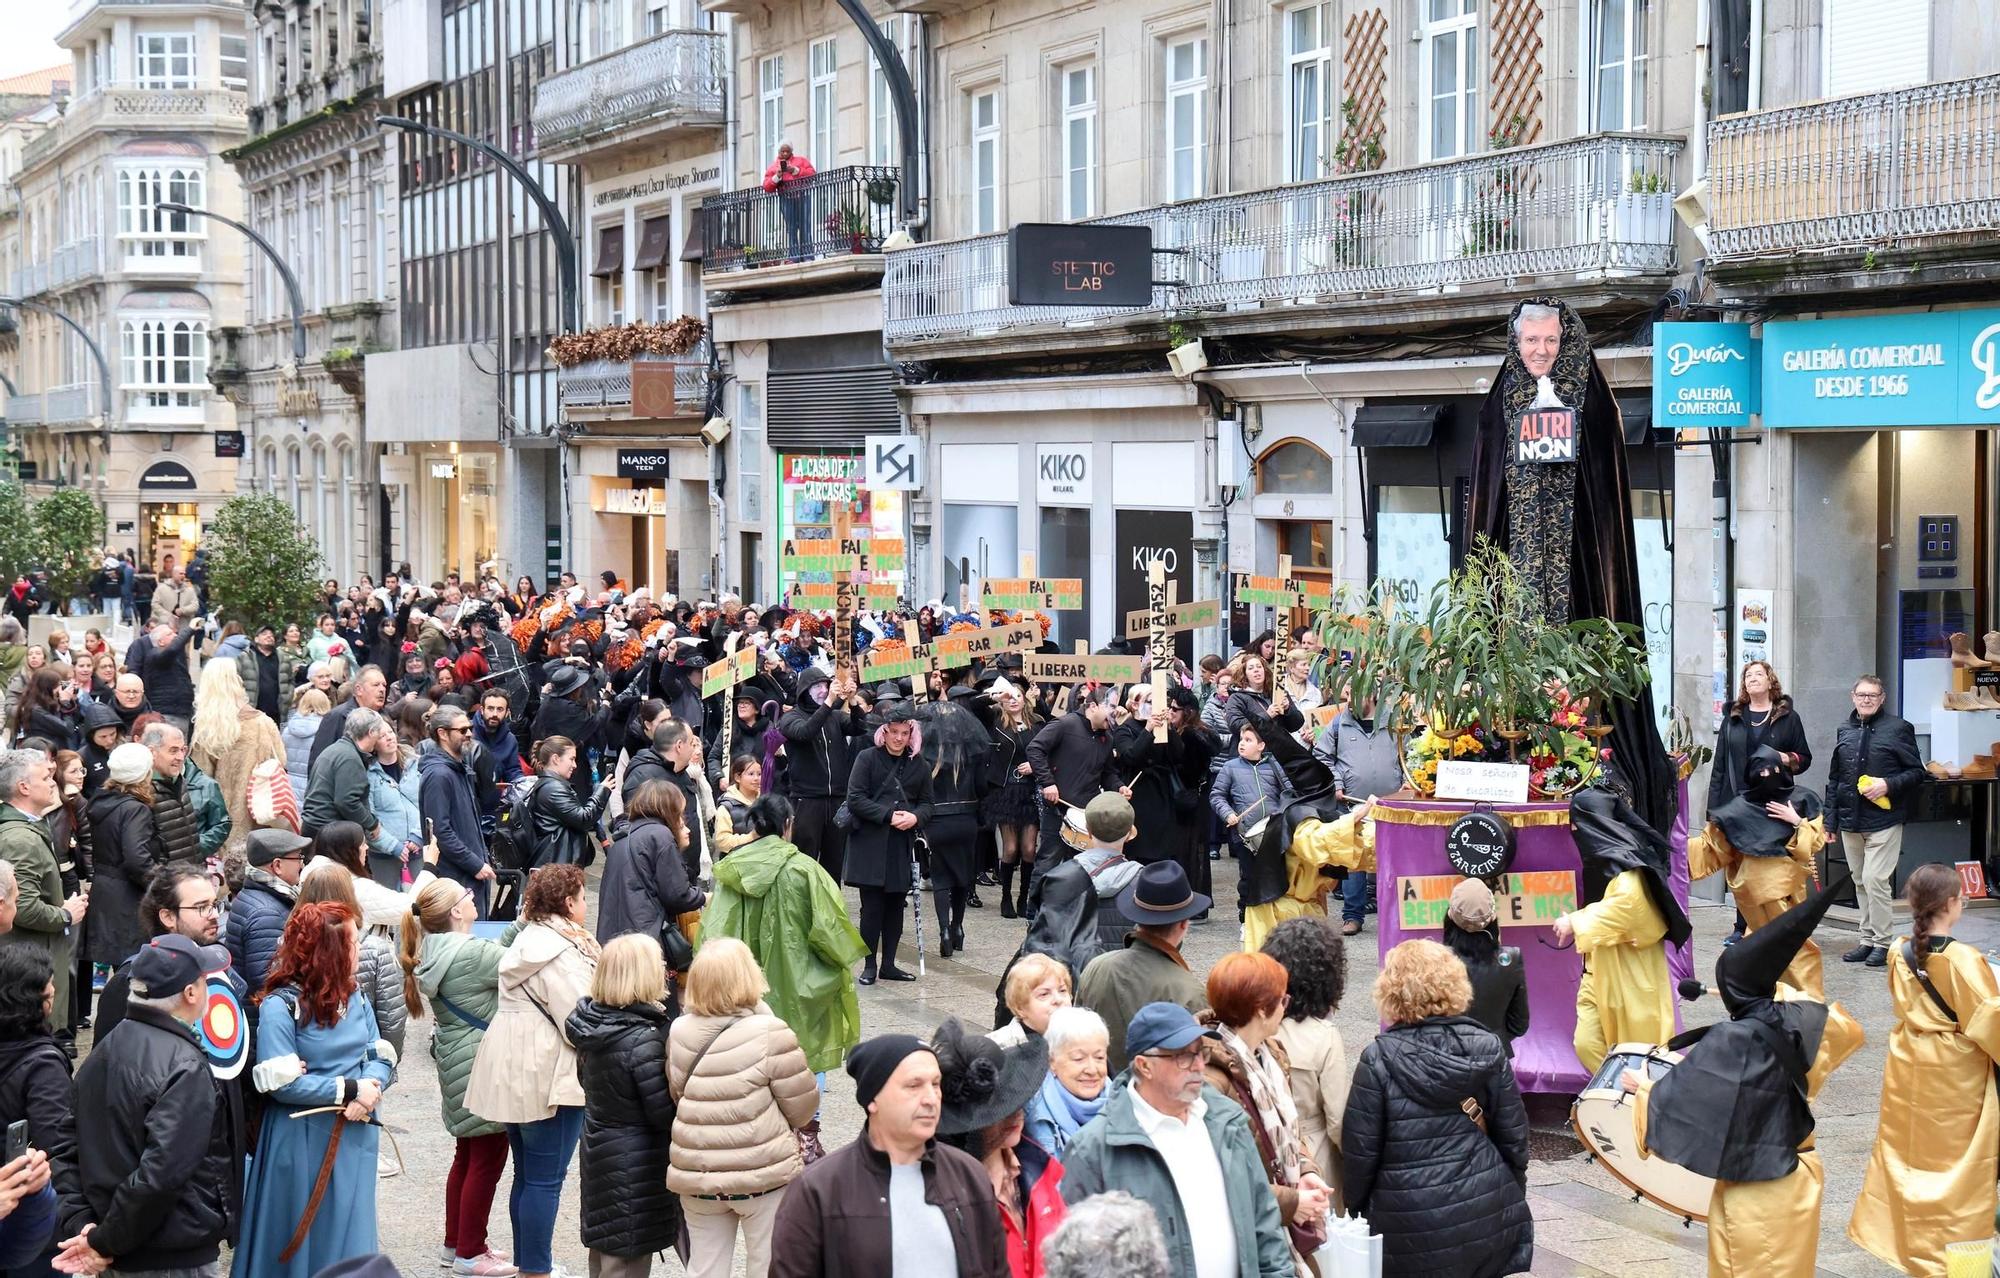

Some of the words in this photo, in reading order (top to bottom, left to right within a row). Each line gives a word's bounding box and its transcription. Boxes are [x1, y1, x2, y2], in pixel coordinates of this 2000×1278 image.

[1064, 275, 1103, 291] LAB
[1667, 341, 1745, 377] Durán
[1783, 343, 1848, 372] GALERÍA
[1851, 343, 1945, 370] COMERCIAL
[1678, 385, 1733, 401] GALERÍA
[1815, 376, 1866, 398] DESDE
[1868, 374, 1909, 397] 1966
[1668, 401, 1743, 415] COMERCIAL
[1520, 411, 1572, 442] ALTRI
[1519, 437, 1572, 461] NON
[621, 455, 667, 465] MANGO
[807, 458, 831, 480] CASA
[1041, 454, 1086, 481] KIKO
[804, 480, 852, 503] CARCASAS
[1284, 500, 1294, 516] 49
[784, 539, 796, 556] A
[841, 539, 860, 555] FAI
[860, 555, 868, 571] E
[1133, 546, 1178, 573] KIKO
[793, 583, 802, 595] A
[983, 581, 992, 595] A
[1029, 580, 1046, 593] FAI
[1241, 575, 1250, 588] A
[1284, 578, 1299, 592] FAI
[836, 581, 851, 622] NON
[859, 597, 866, 611] E
[1046, 594, 1053, 608] E
[1298, 594, 1305, 608] E
[1007, 629, 1033, 647] AP9
[863, 654, 872, 667] A
[912, 644, 931, 659] FAI
[1150, 631, 1165, 671] NON
[931, 656, 940, 670] E
[1031, 663, 1086, 677] LIBERAR
[1404, 879, 1417, 901] A
[1511, 874, 1524, 894] A
[1960, 866, 1981, 894] 19
[1512, 896, 1522, 920] E
